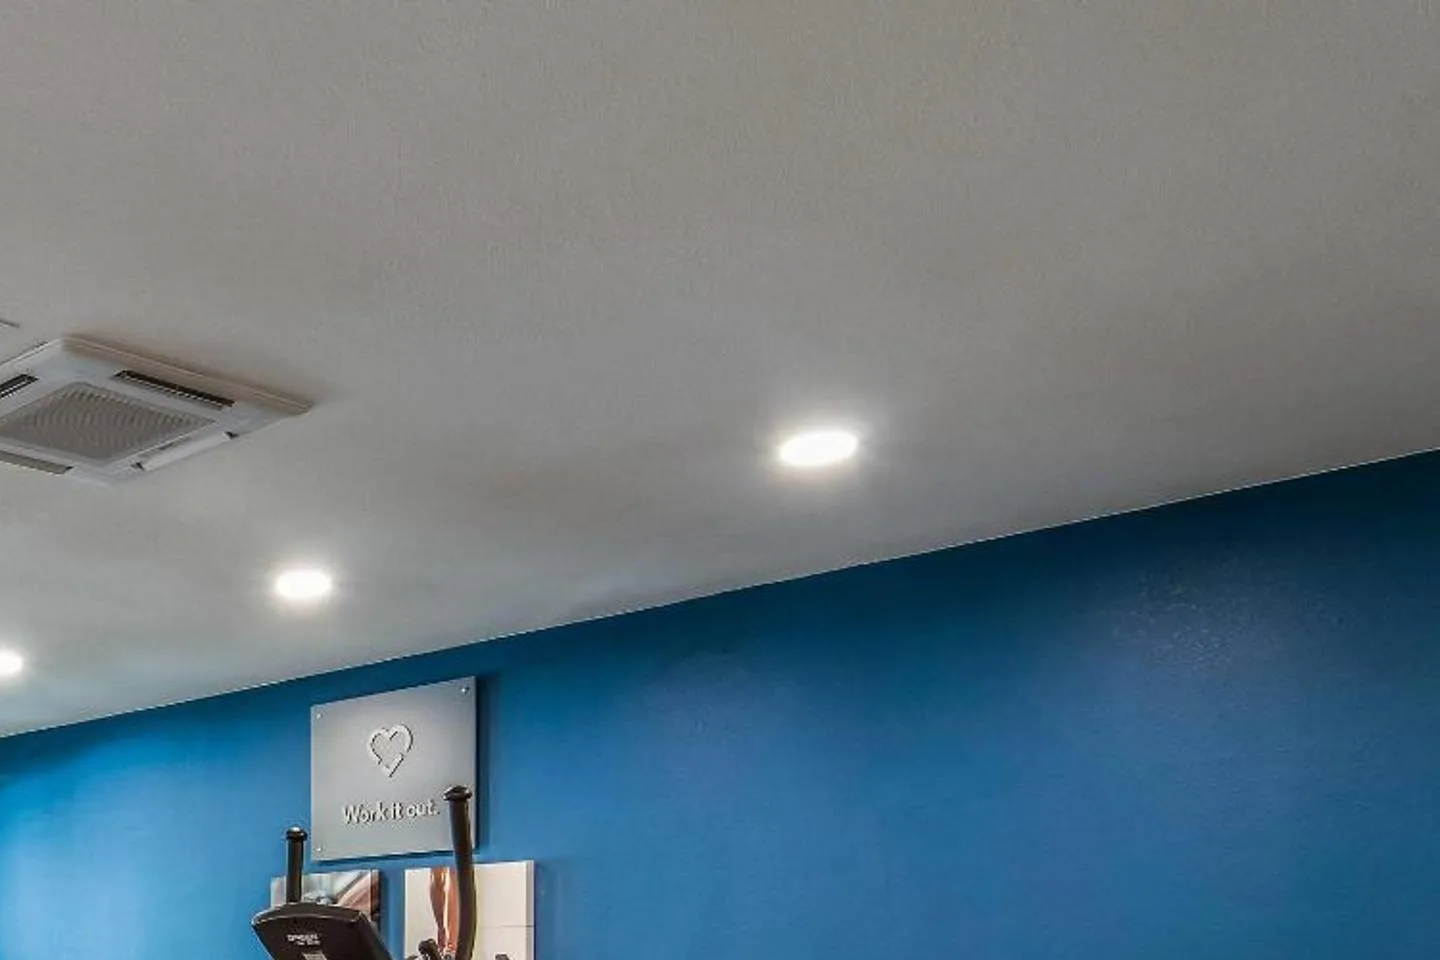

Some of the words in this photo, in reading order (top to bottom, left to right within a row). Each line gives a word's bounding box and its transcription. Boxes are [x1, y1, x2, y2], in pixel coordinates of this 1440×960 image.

[342, 802, 388, 824] Work
[391, 801, 403, 820] it
[406, 799, 440, 818] out.
